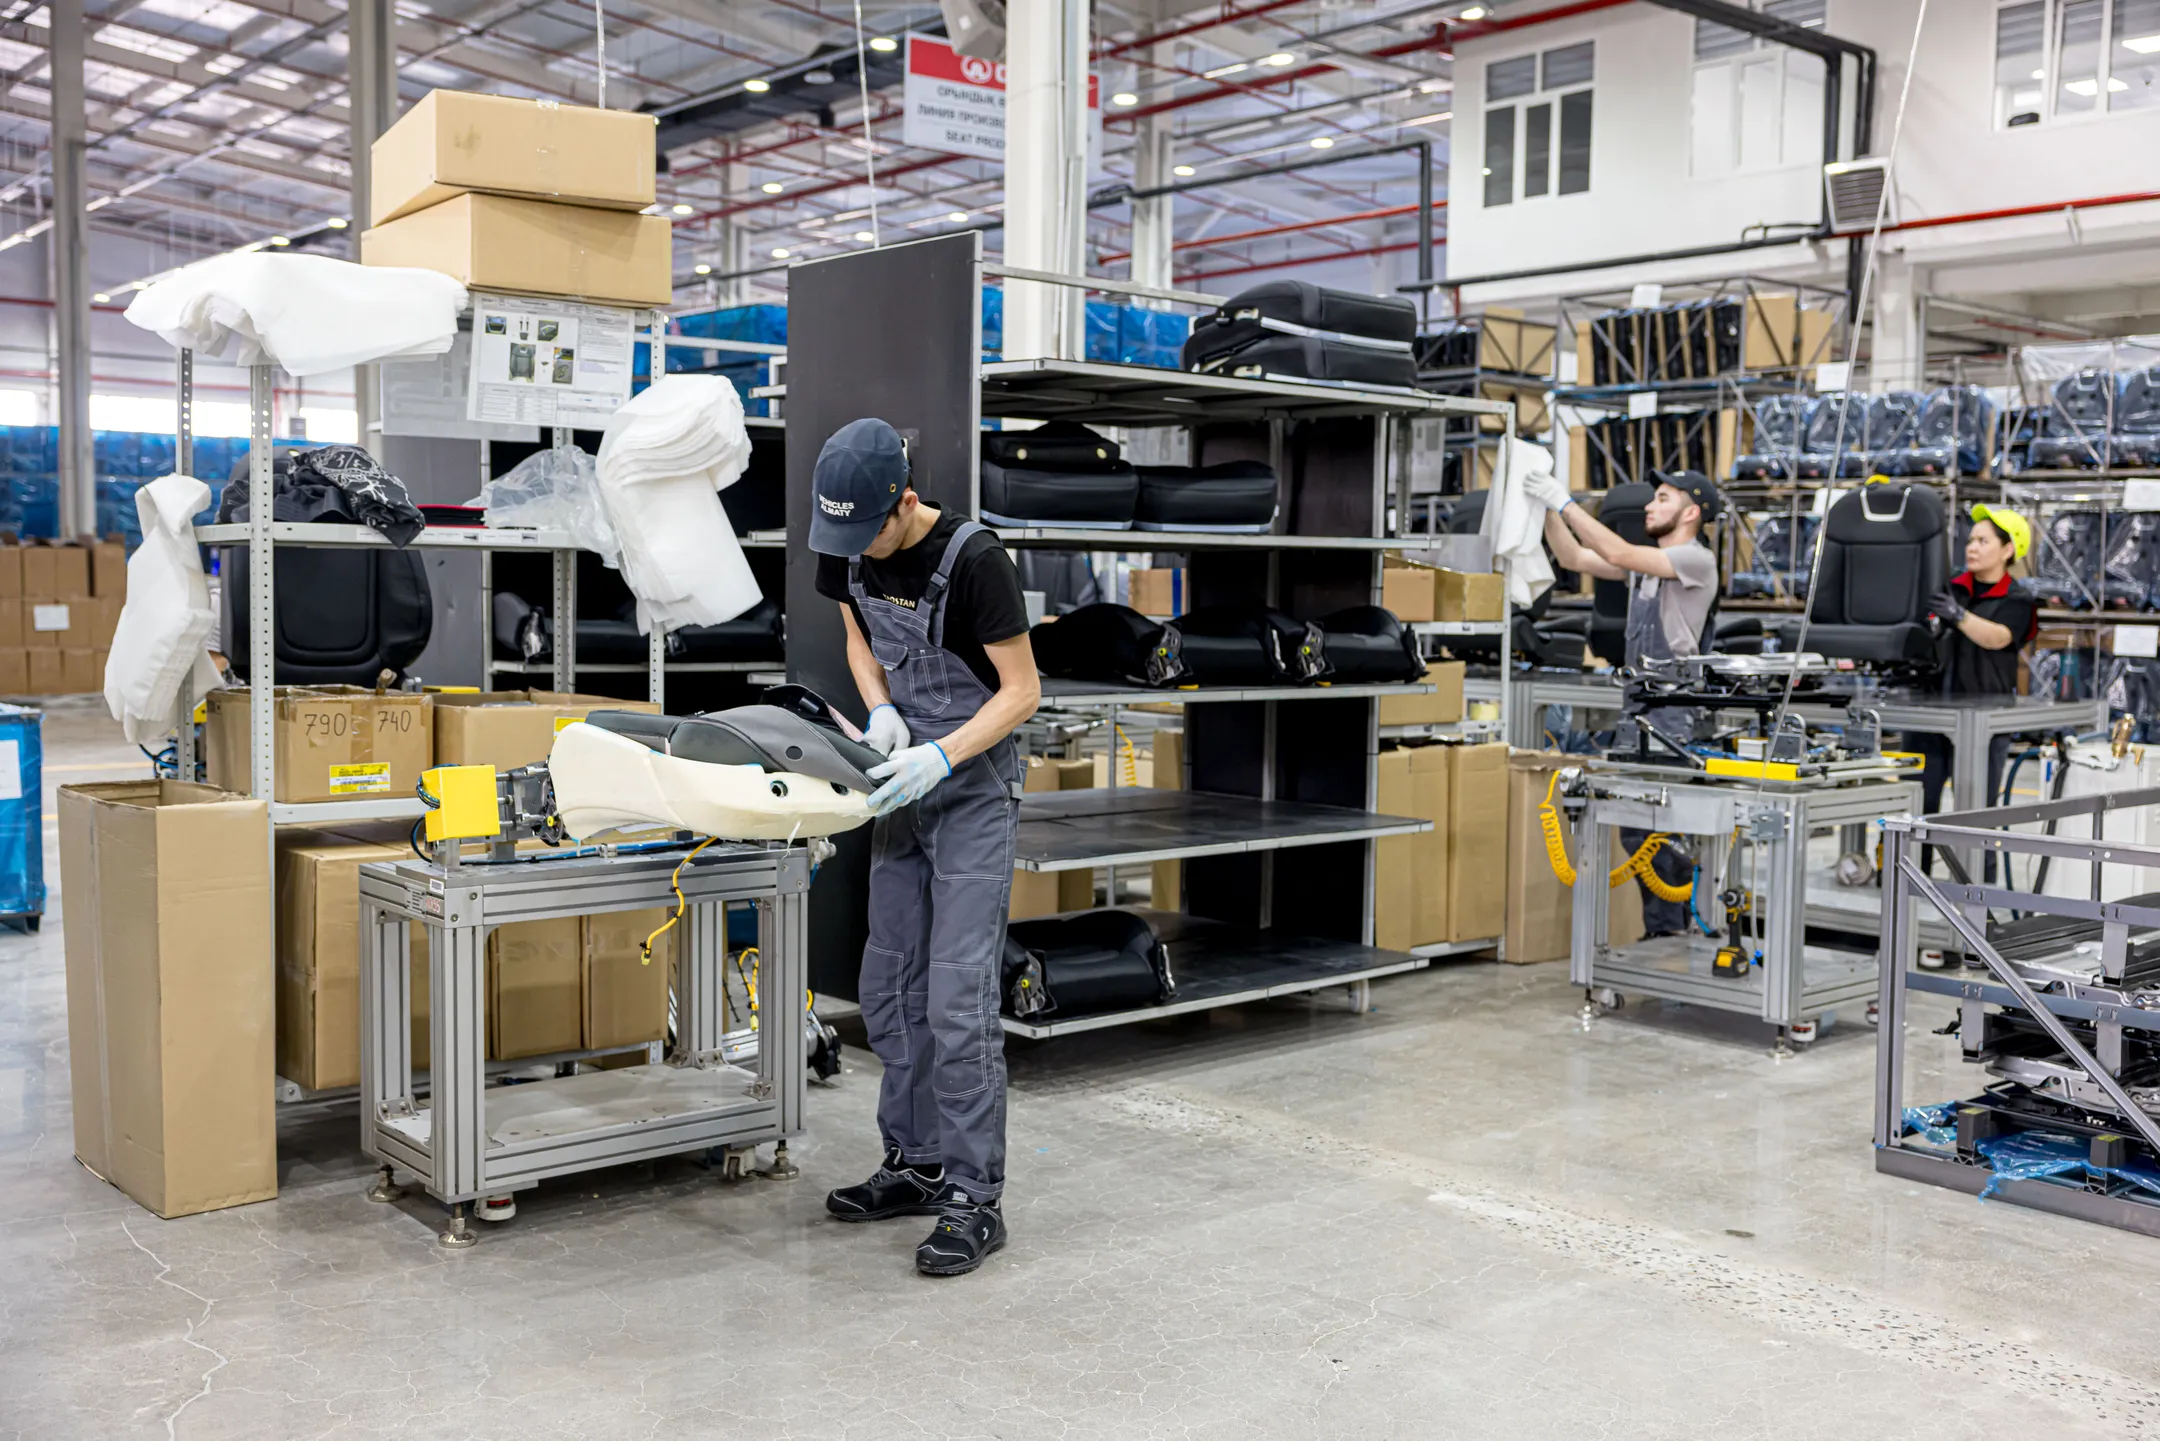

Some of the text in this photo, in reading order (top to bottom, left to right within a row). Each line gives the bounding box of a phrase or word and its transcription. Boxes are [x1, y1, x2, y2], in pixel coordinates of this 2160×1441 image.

[918, 104, 955, 119] ЛИНИЯ
[946, 130, 1004, 149] SEAT PROD
[818, 494, 854, 509] VEHICLES
[821, 504, 850, 516] ALMATY
[304, 712, 347, 736] 790
[377, 709, 412, 733] 740
